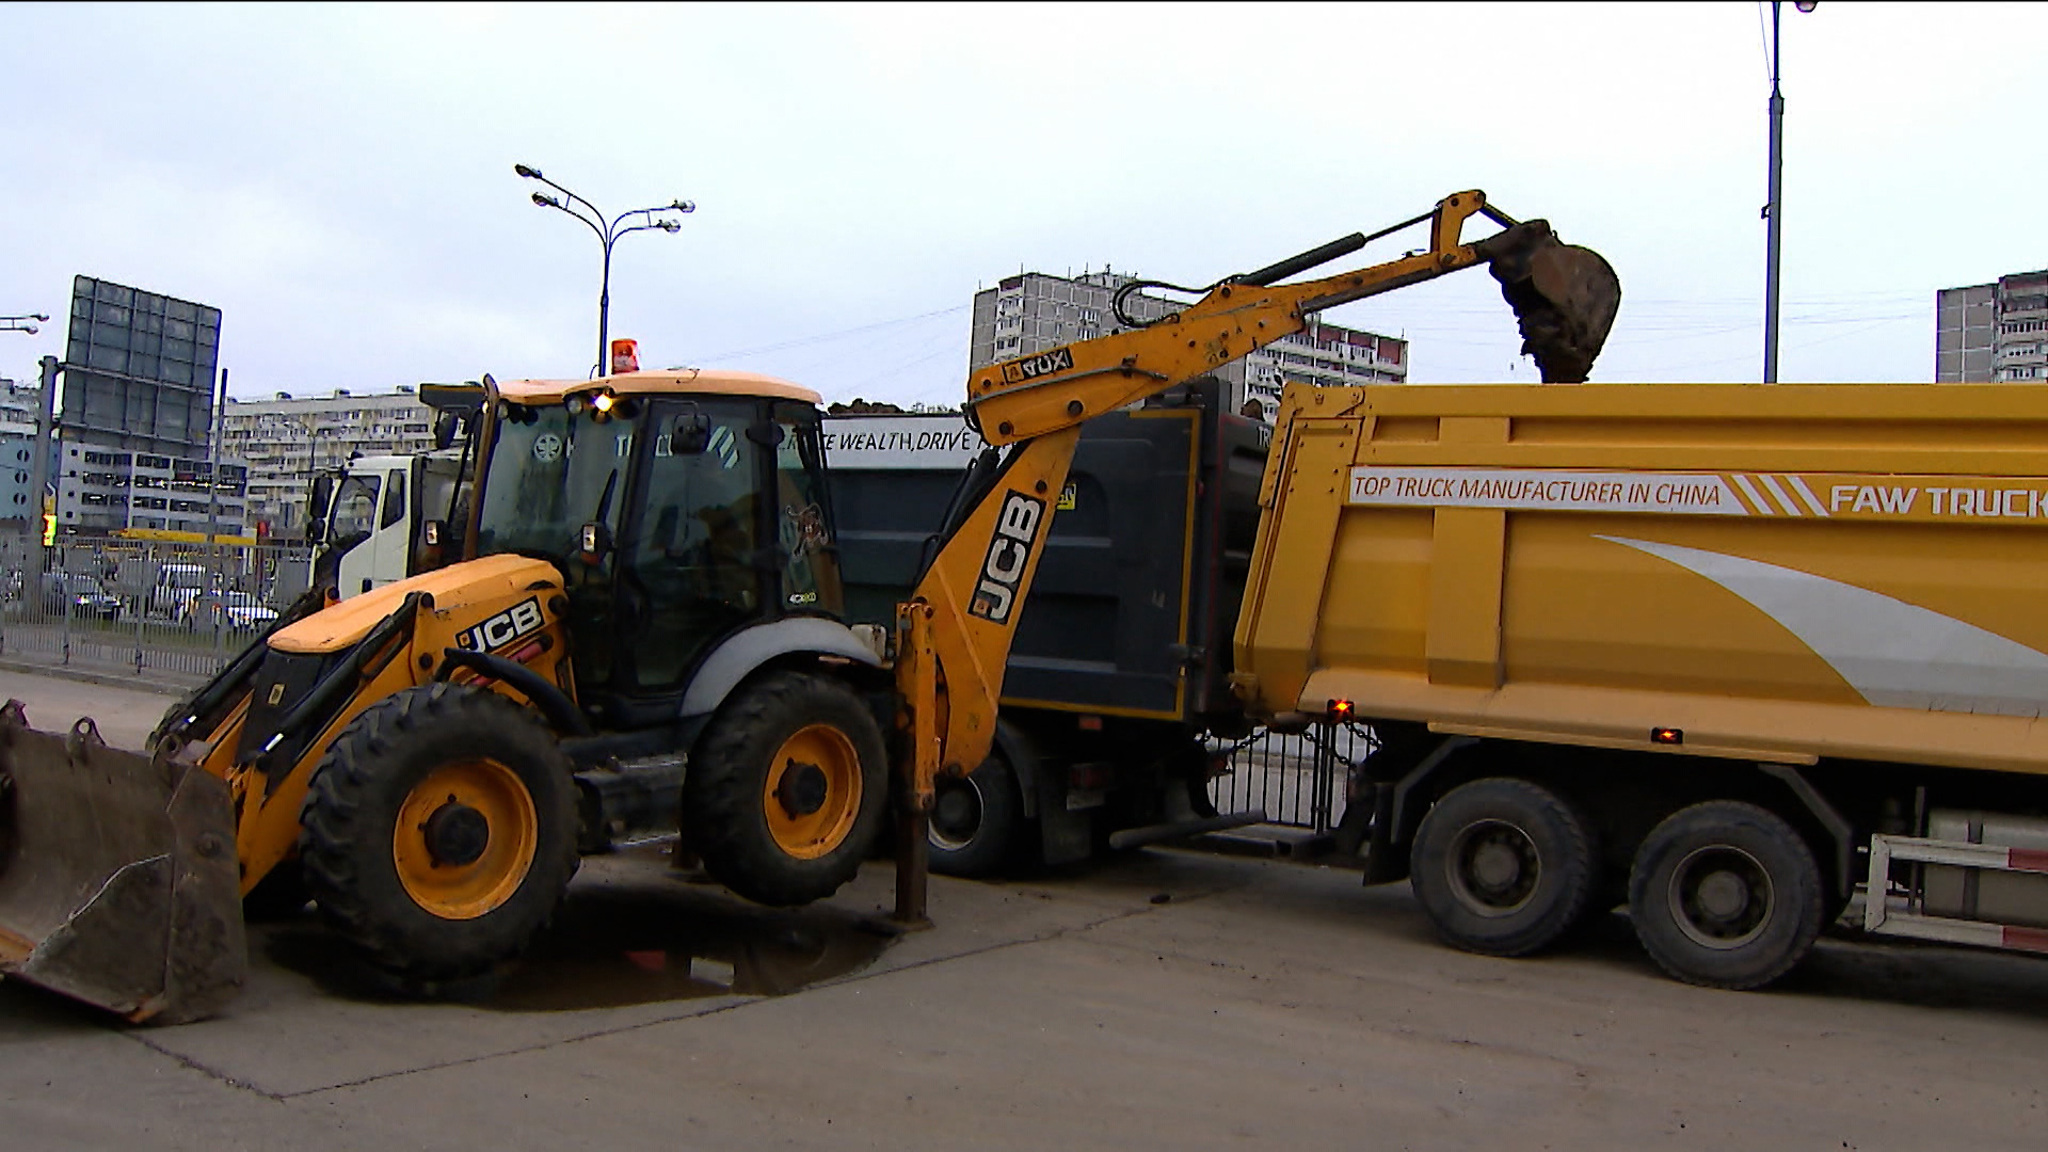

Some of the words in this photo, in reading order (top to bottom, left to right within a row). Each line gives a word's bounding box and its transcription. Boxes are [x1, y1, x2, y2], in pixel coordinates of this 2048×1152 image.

[1354, 476, 1391, 496] TOP
[1395, 477, 1456, 499] TRUCK
[1458, 478, 1622, 504] MANUFACTURER
[1627, 483, 1651, 504] IN
[1655, 483, 1721, 507] CHINA
[1830, 485, 1918, 515] FAW
[980, 494, 1043, 620] JCB
[466, 599, 542, 653] JCB
